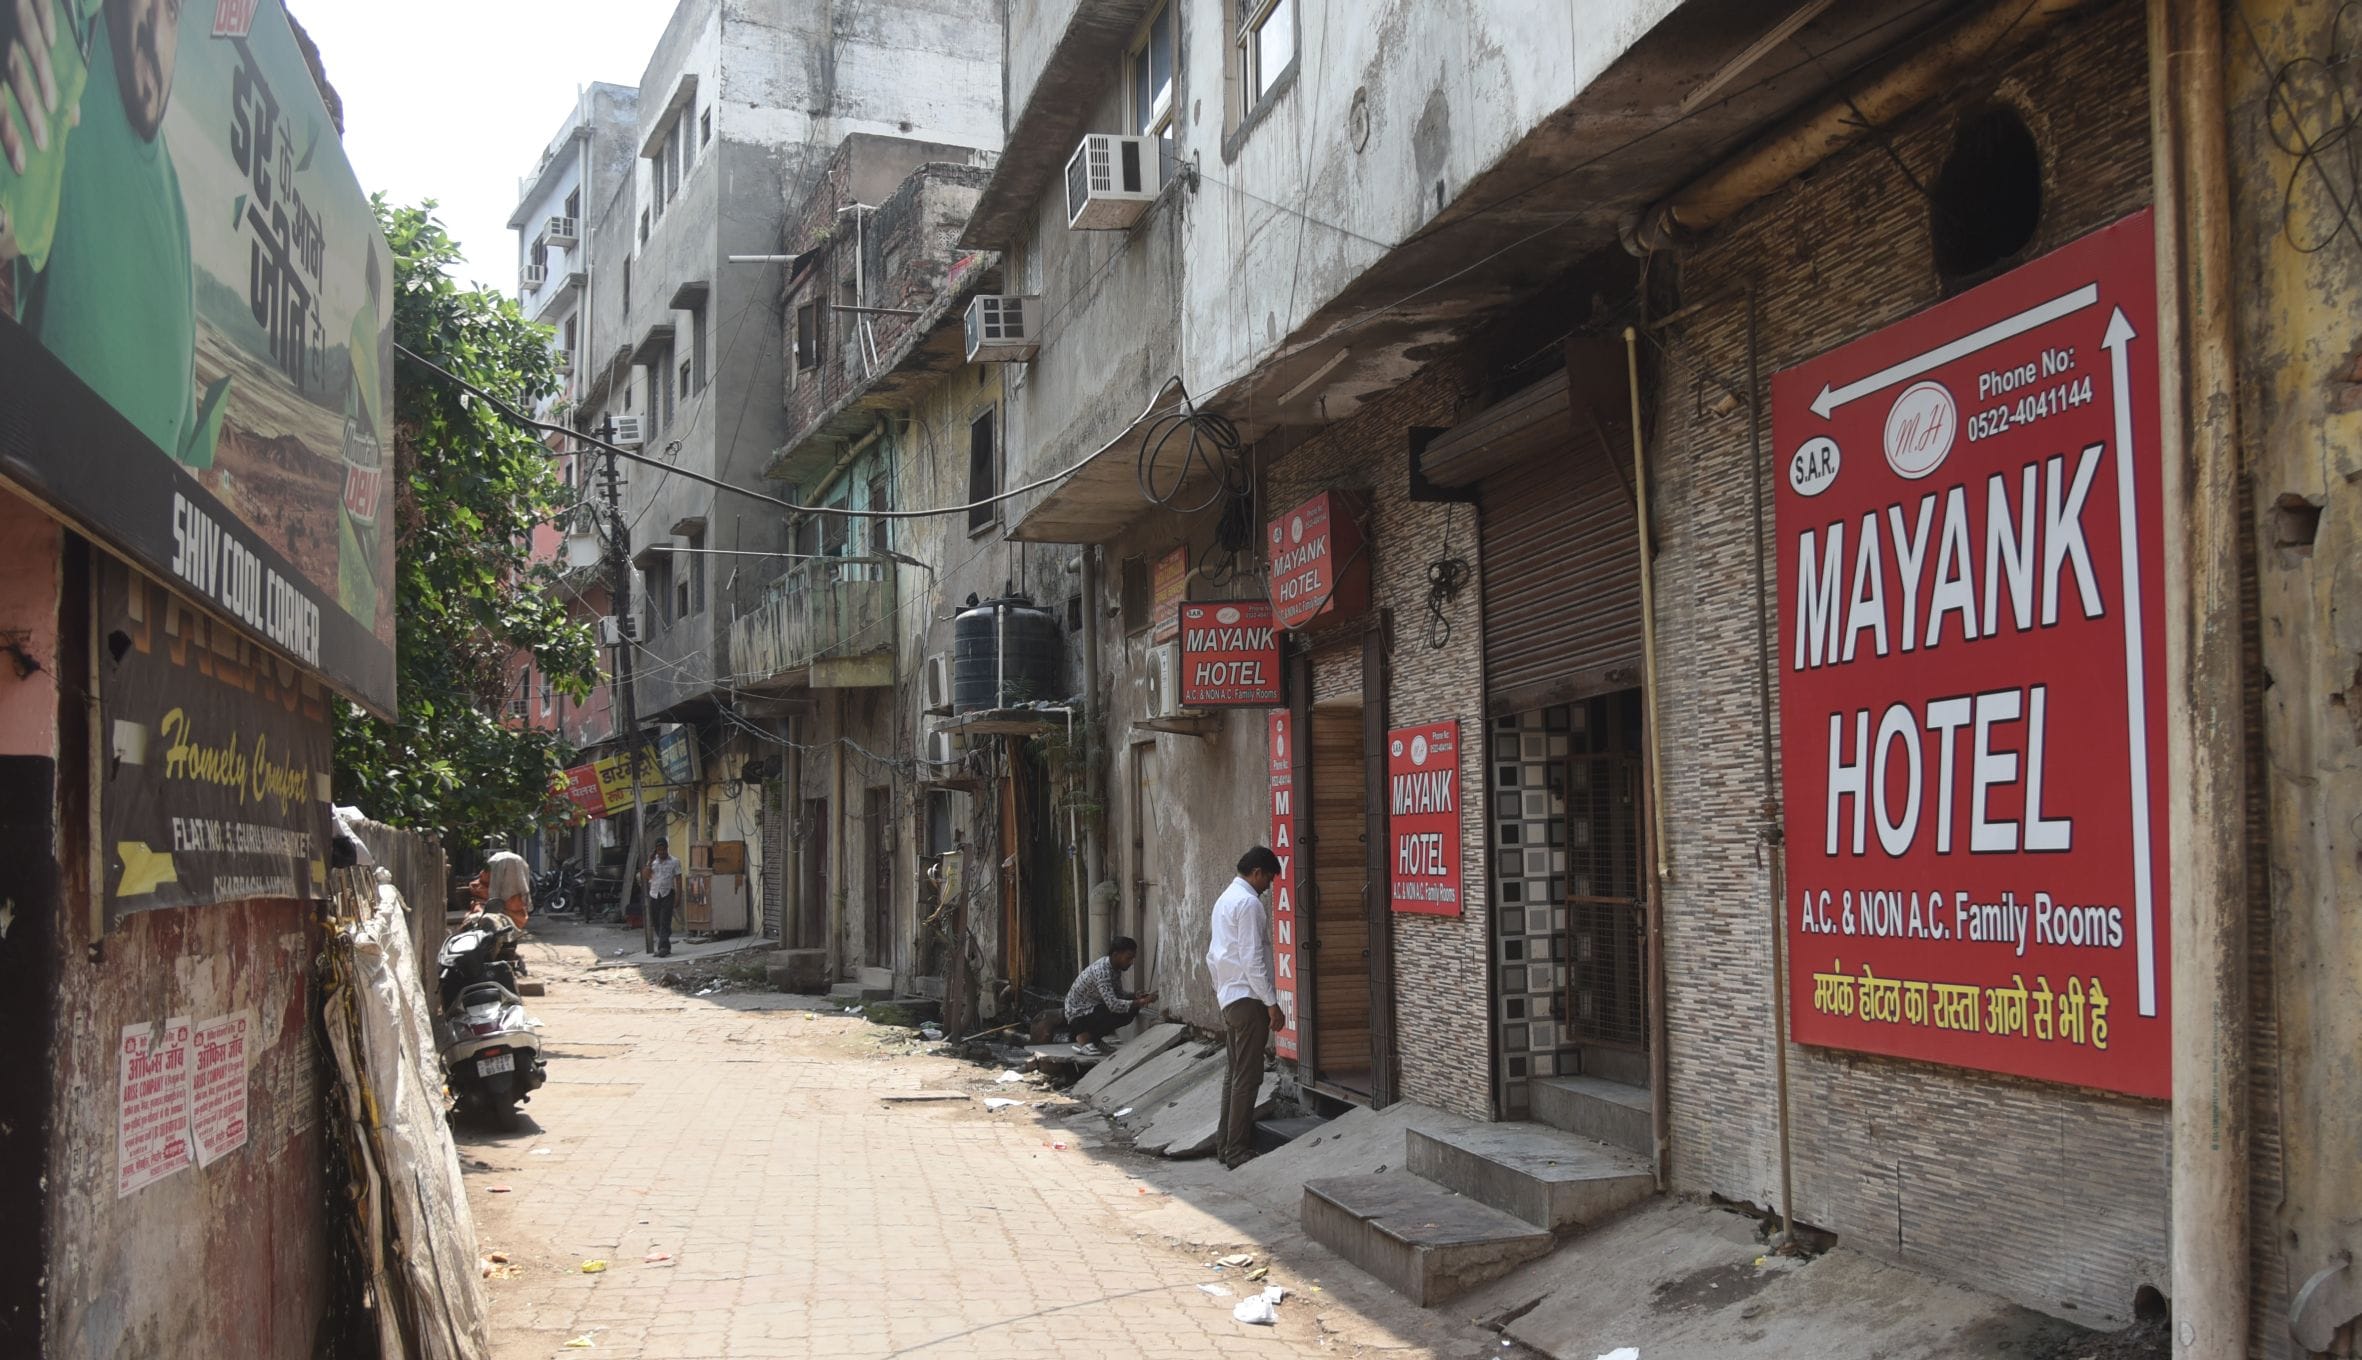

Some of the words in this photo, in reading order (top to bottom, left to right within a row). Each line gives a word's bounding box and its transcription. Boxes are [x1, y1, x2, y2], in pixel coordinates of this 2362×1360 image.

[278, 117, 294, 204] के
[291, 188, 326, 296] आगे
[247, 201, 311, 396] जीत
[1979, 362, 2037, 401] Phone
[2041, 347, 2075, 375] No:
[1968, 376, 2093, 442] 0522-4041144
[1795, 446, 1836, 485] S.A.R.
[172, 491, 221, 599] SHIV
[222, 532, 264, 632] COOL
[266, 568, 320, 669] CORNER
[1274, 535, 1326, 577] MAYANK
[1793, 441, 2106, 673] MAYANK
[1280, 568, 1323, 603] HOTEL
[1186, 627, 1275, 652] MAYANK
[1195, 661, 1266, 686] HOTEL
[1206, 689, 1219, 699] NON
[1256, 688, 1277, 698] Rooms
[161, 707, 247, 806] Homely
[252, 732, 308, 816] Comfort
[1825, 683, 2073, 858] HOTEL
[1391, 769, 1453, 815] MAYANK
[172, 816, 204, 851] FLAT
[205, 820, 225, 851] NO.
[236, 823, 261, 852] GURU
[1398, 832, 1447, 876] HOTEL
[1275, 791, 1292, 979] MAYANK
[1801, 888, 1837, 936] A.C.
[1842, 889, 1856, 936] &
[1859, 890, 1903, 938] NON
[1908, 891, 1951, 940] A.C.
[1955, 892, 2029, 956] Family
[2034, 892, 2124, 948] Rooms
[1813, 958, 1855, 1017] मयंक
[1857, 964, 1902, 1023] होटल
[1903, 980, 1929, 1026] का
[1932, 982, 1981, 1032] रास्ता
[1984, 974, 2028, 1038] आगे
[2033, 976, 2053, 1041] से
[2059, 976, 2086, 1045] भी
[2088, 977, 2110, 1050] है
[166, 1042, 184, 1070] जॉब
[228, 1033, 244, 1059] जॉब
